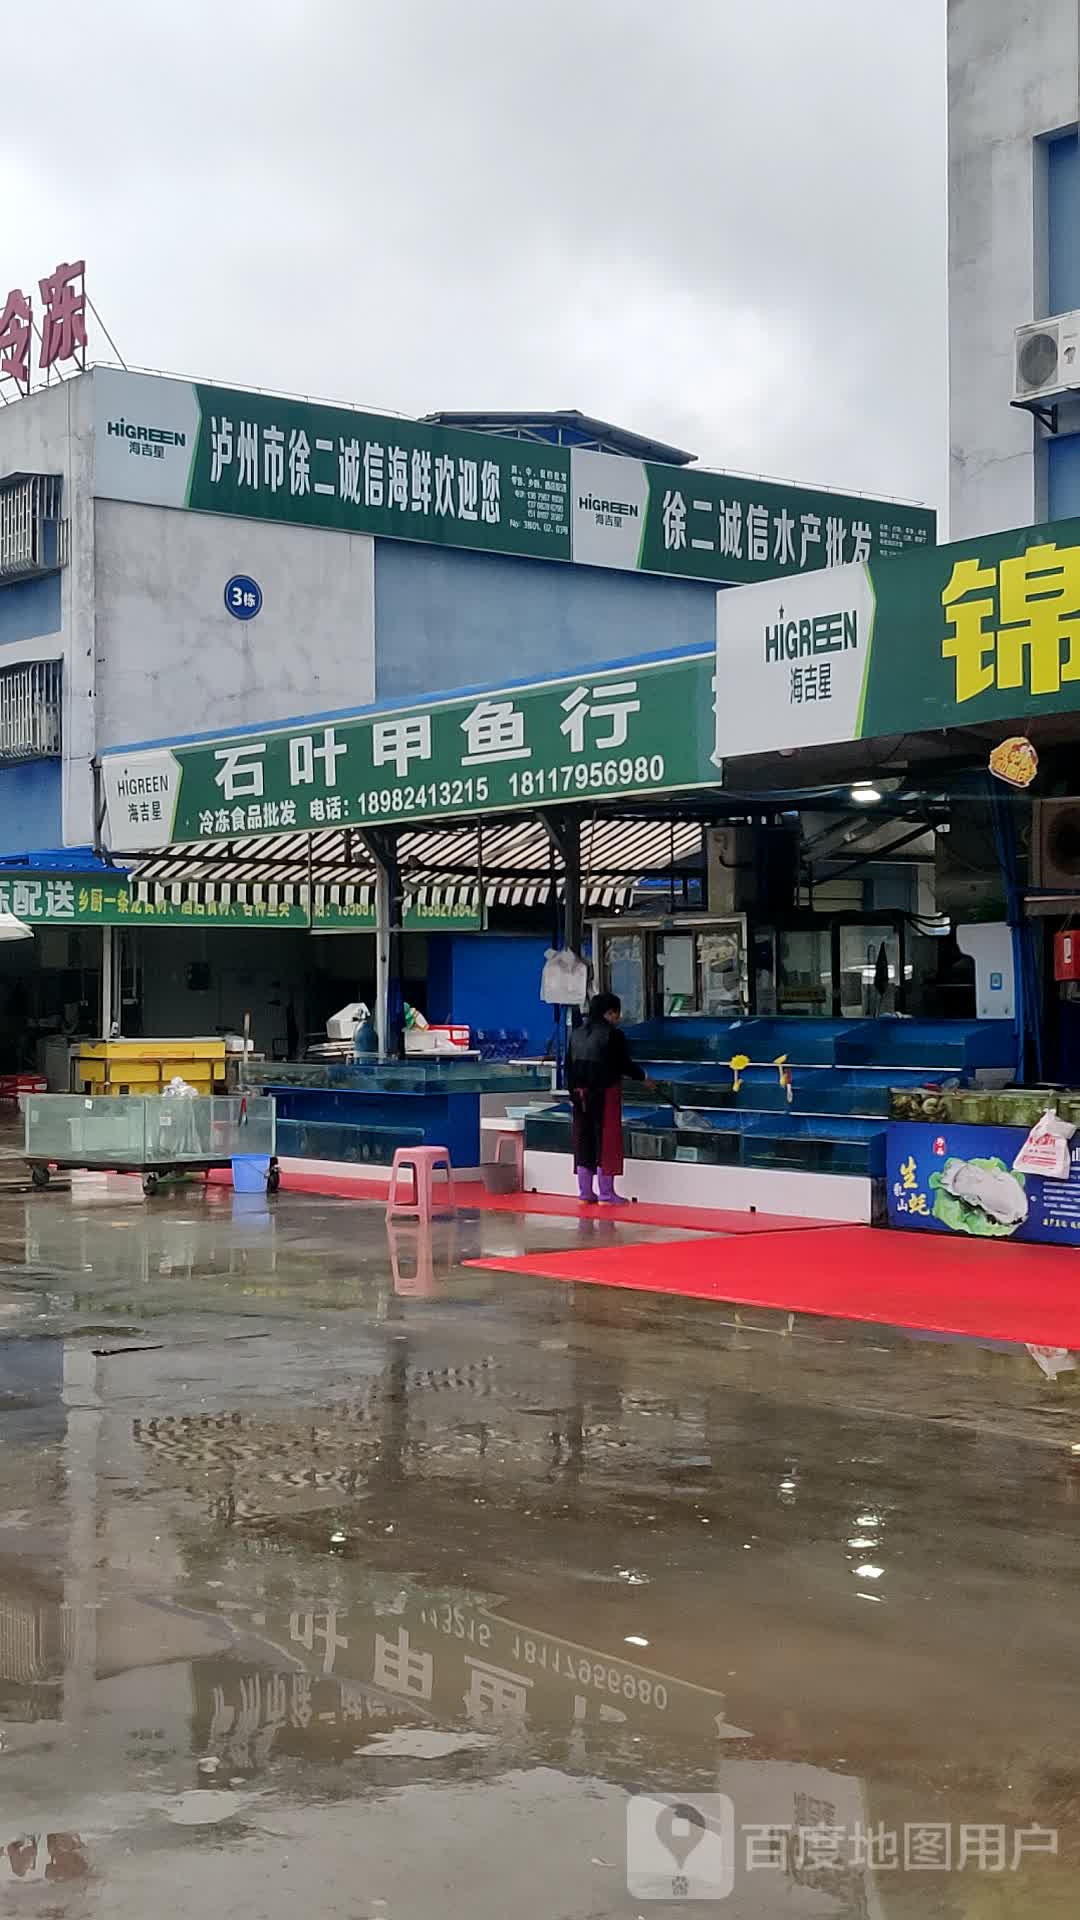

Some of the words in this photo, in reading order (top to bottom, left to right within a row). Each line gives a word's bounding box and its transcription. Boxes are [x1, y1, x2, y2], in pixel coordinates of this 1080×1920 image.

[129, 441, 165, 459] 海吉星
[210, 416, 501, 524] 泸州市徐二诚信海鲜欢迎您
[595, 514, 623, 529] 海吉星
[662, 490, 872, 568] 徐二诚信水产批发
[232, 587, 256, 607] 3栋
[941, 543, 1080, 704] 锦
[790, 662, 832, 704] 海吉星
[214, 681, 641, 801] 石叶甲鱼行
[117, 775, 169, 797] HIGREEN
[198, 800, 297, 835] 冷冻食品批发
[357, 776, 489, 816] 18982413215
[508, 755, 665, 797] 18117956980
[127, 800, 163, 823] 海吉星
